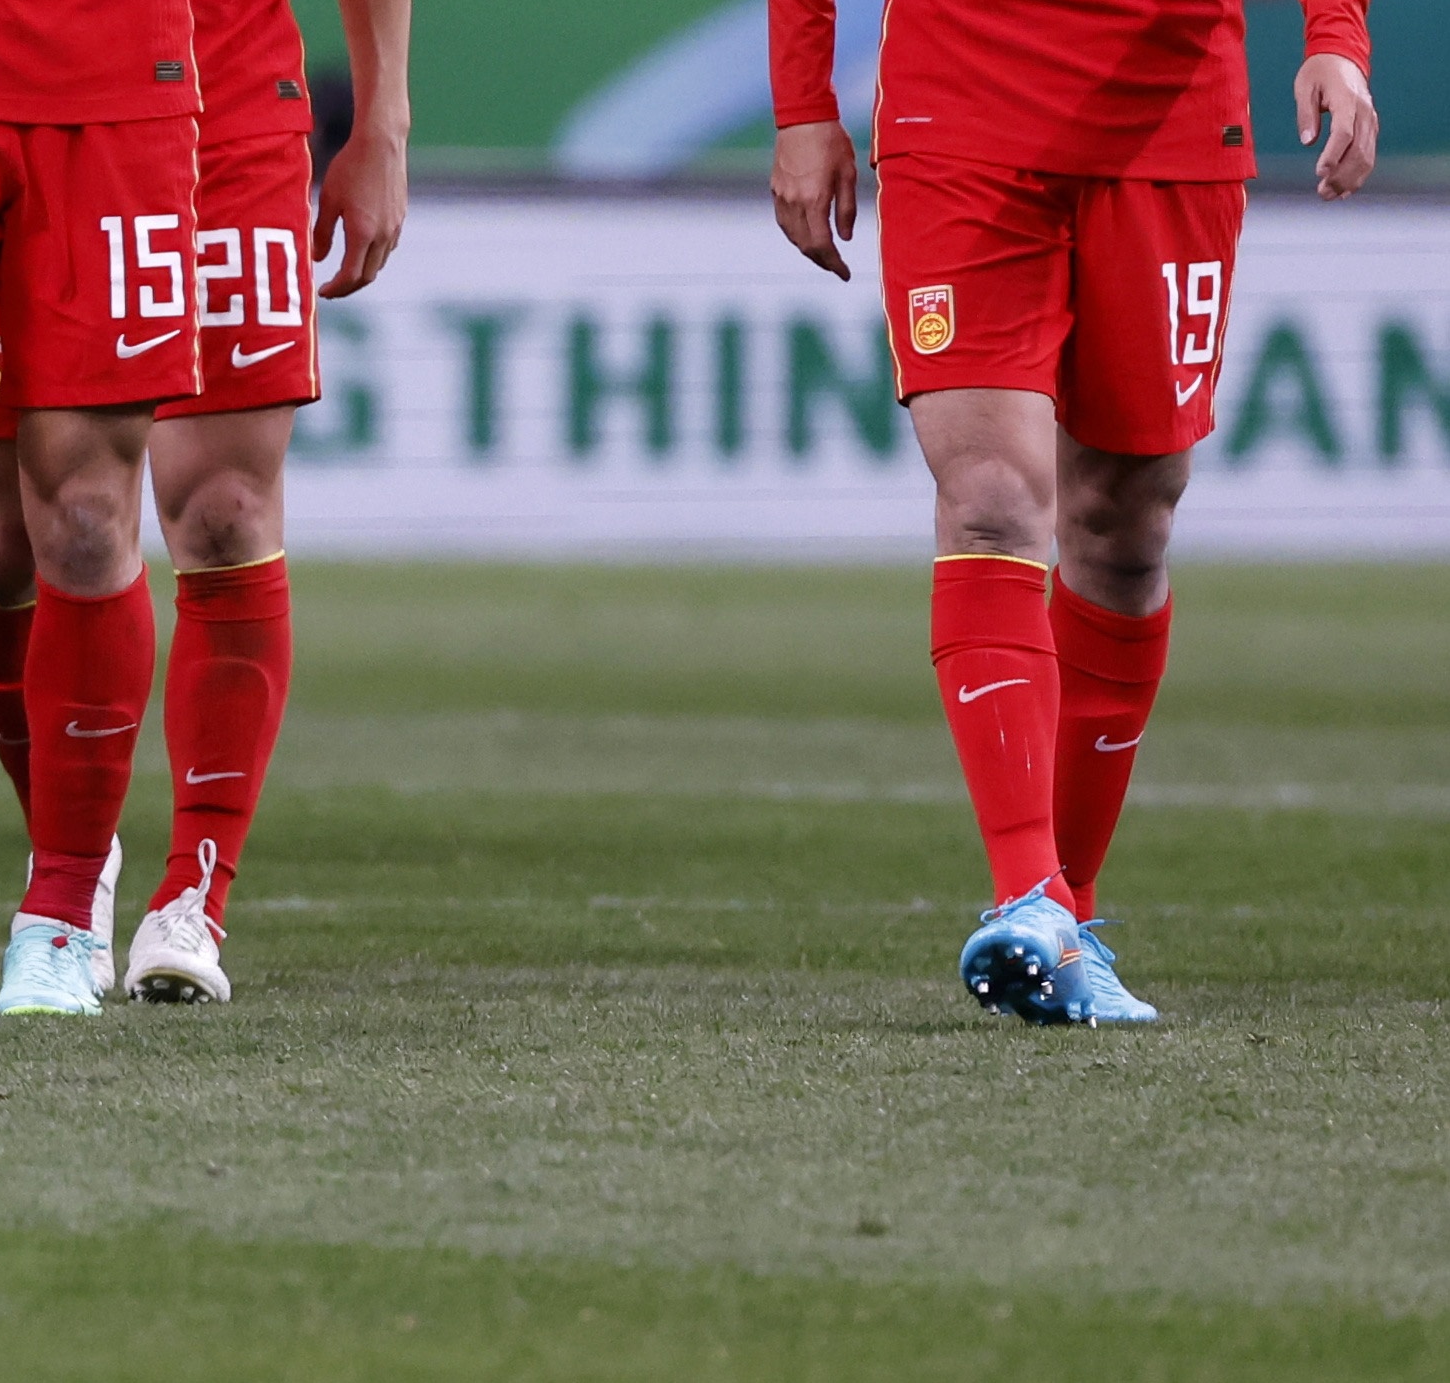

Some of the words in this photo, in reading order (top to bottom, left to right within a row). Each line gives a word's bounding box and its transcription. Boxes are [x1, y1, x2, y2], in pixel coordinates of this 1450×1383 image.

[100, 213, 186, 319] 15
[195, 227, 303, 327] 20
[912, 291, 948, 308] CFA
[1161, 260, 1223, 366] 19
